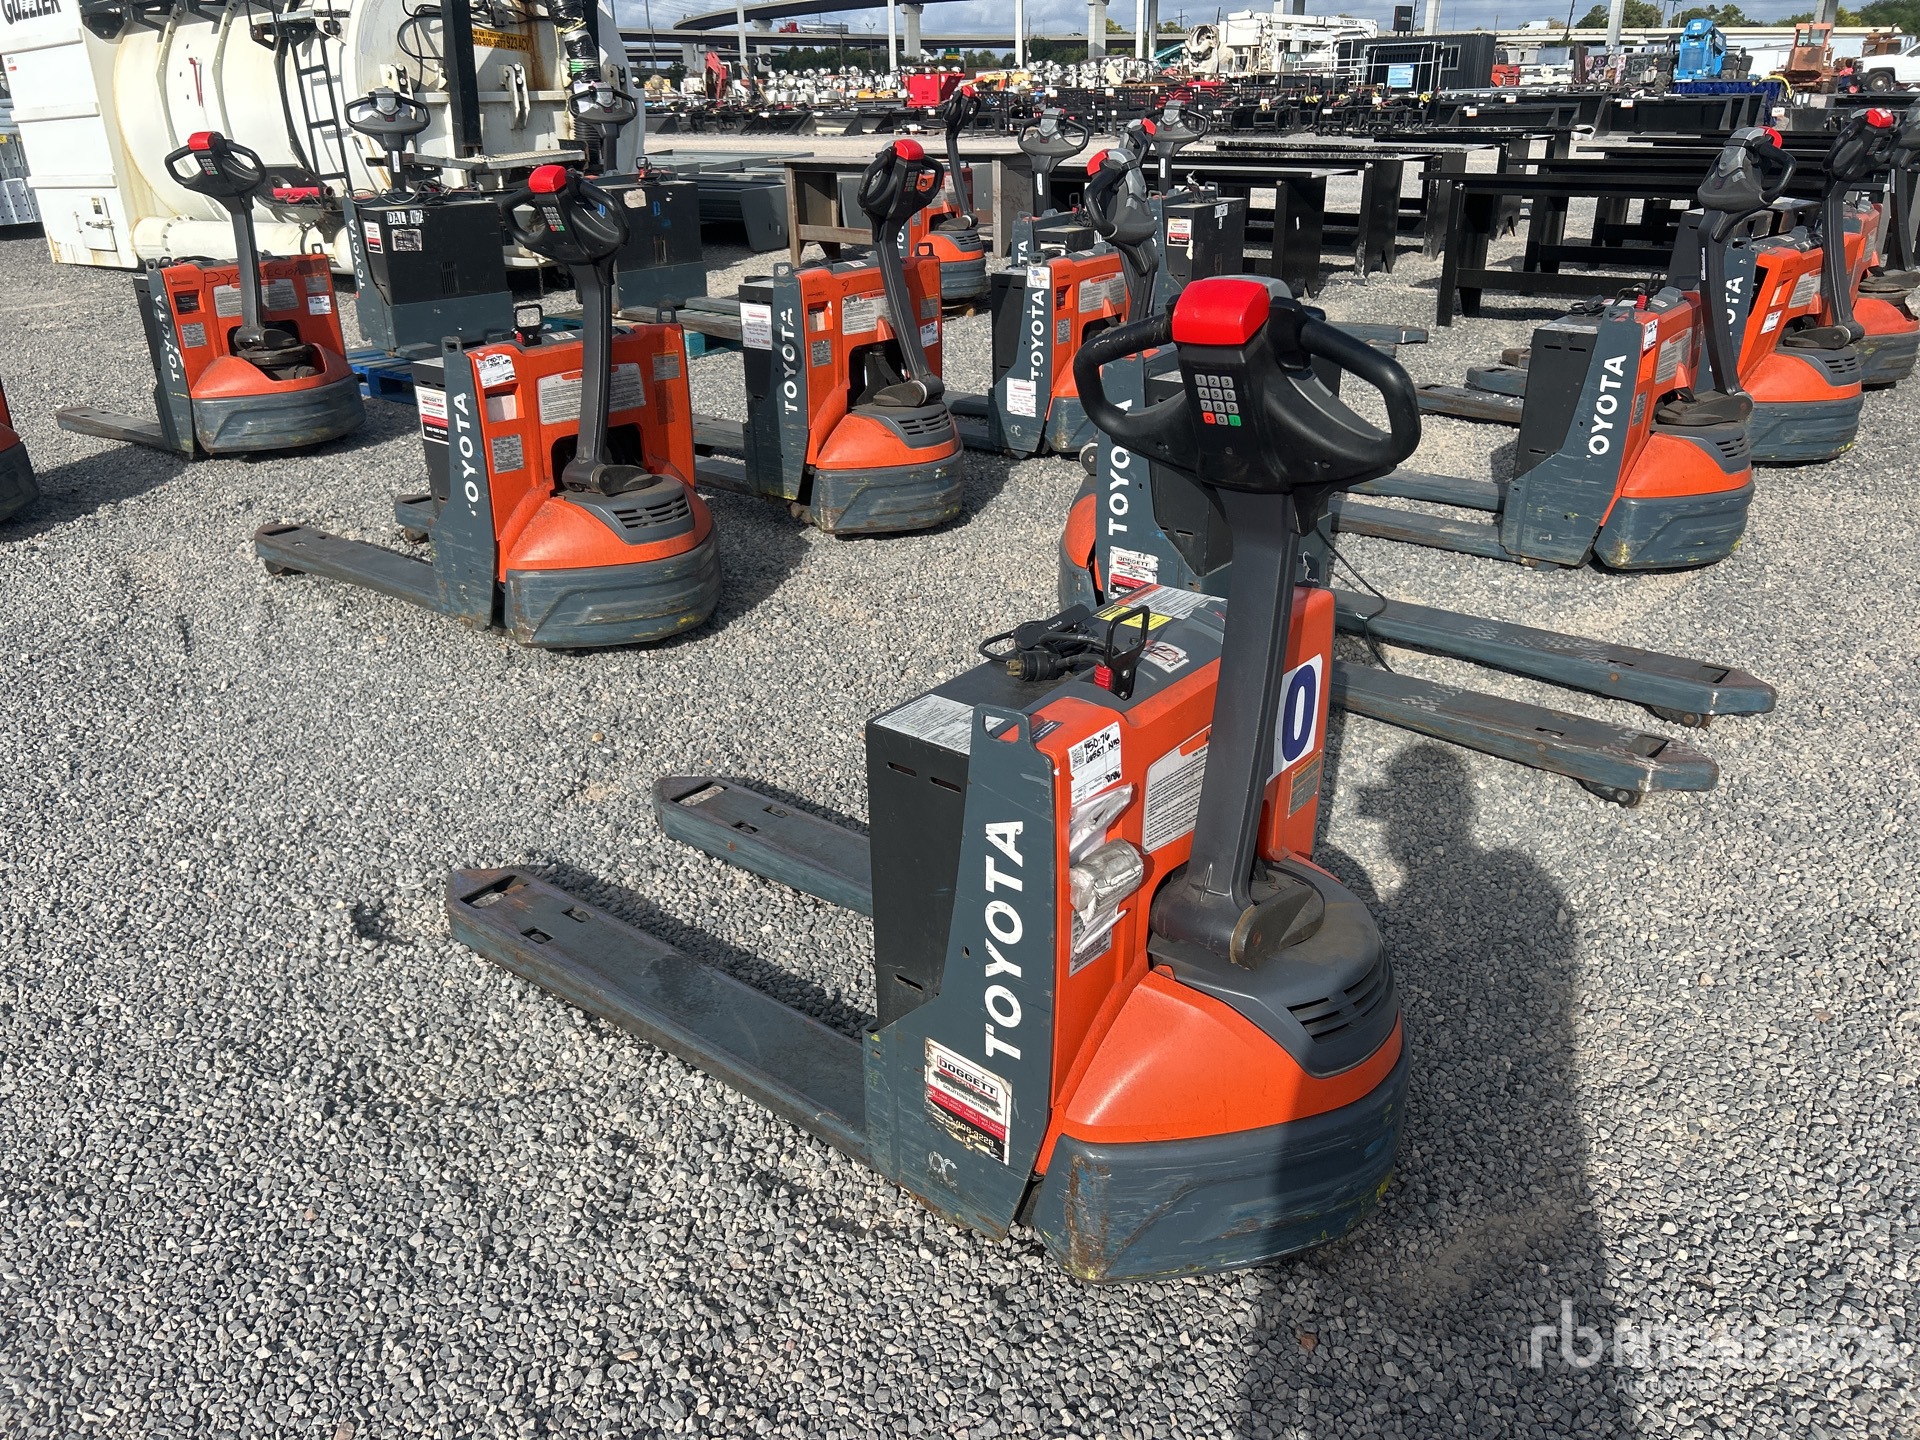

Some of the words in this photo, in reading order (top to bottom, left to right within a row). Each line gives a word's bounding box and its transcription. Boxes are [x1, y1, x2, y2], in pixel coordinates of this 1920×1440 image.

[349, 219, 365, 289] TOYOTA
[387, 212, 405, 223] DAL
[780, 308, 798, 415] TOYOTA
[1030, 290, 1044, 381] TOYOTA
[1587, 355, 1627, 457] OYOTA
[454, 392, 479, 516] OYOTA
[985, 821, 1023, 1060] TOYOTA
[938, 1055, 996, 1095] DOGGETT
[967, 1097, 990, 1113] PARTNER
